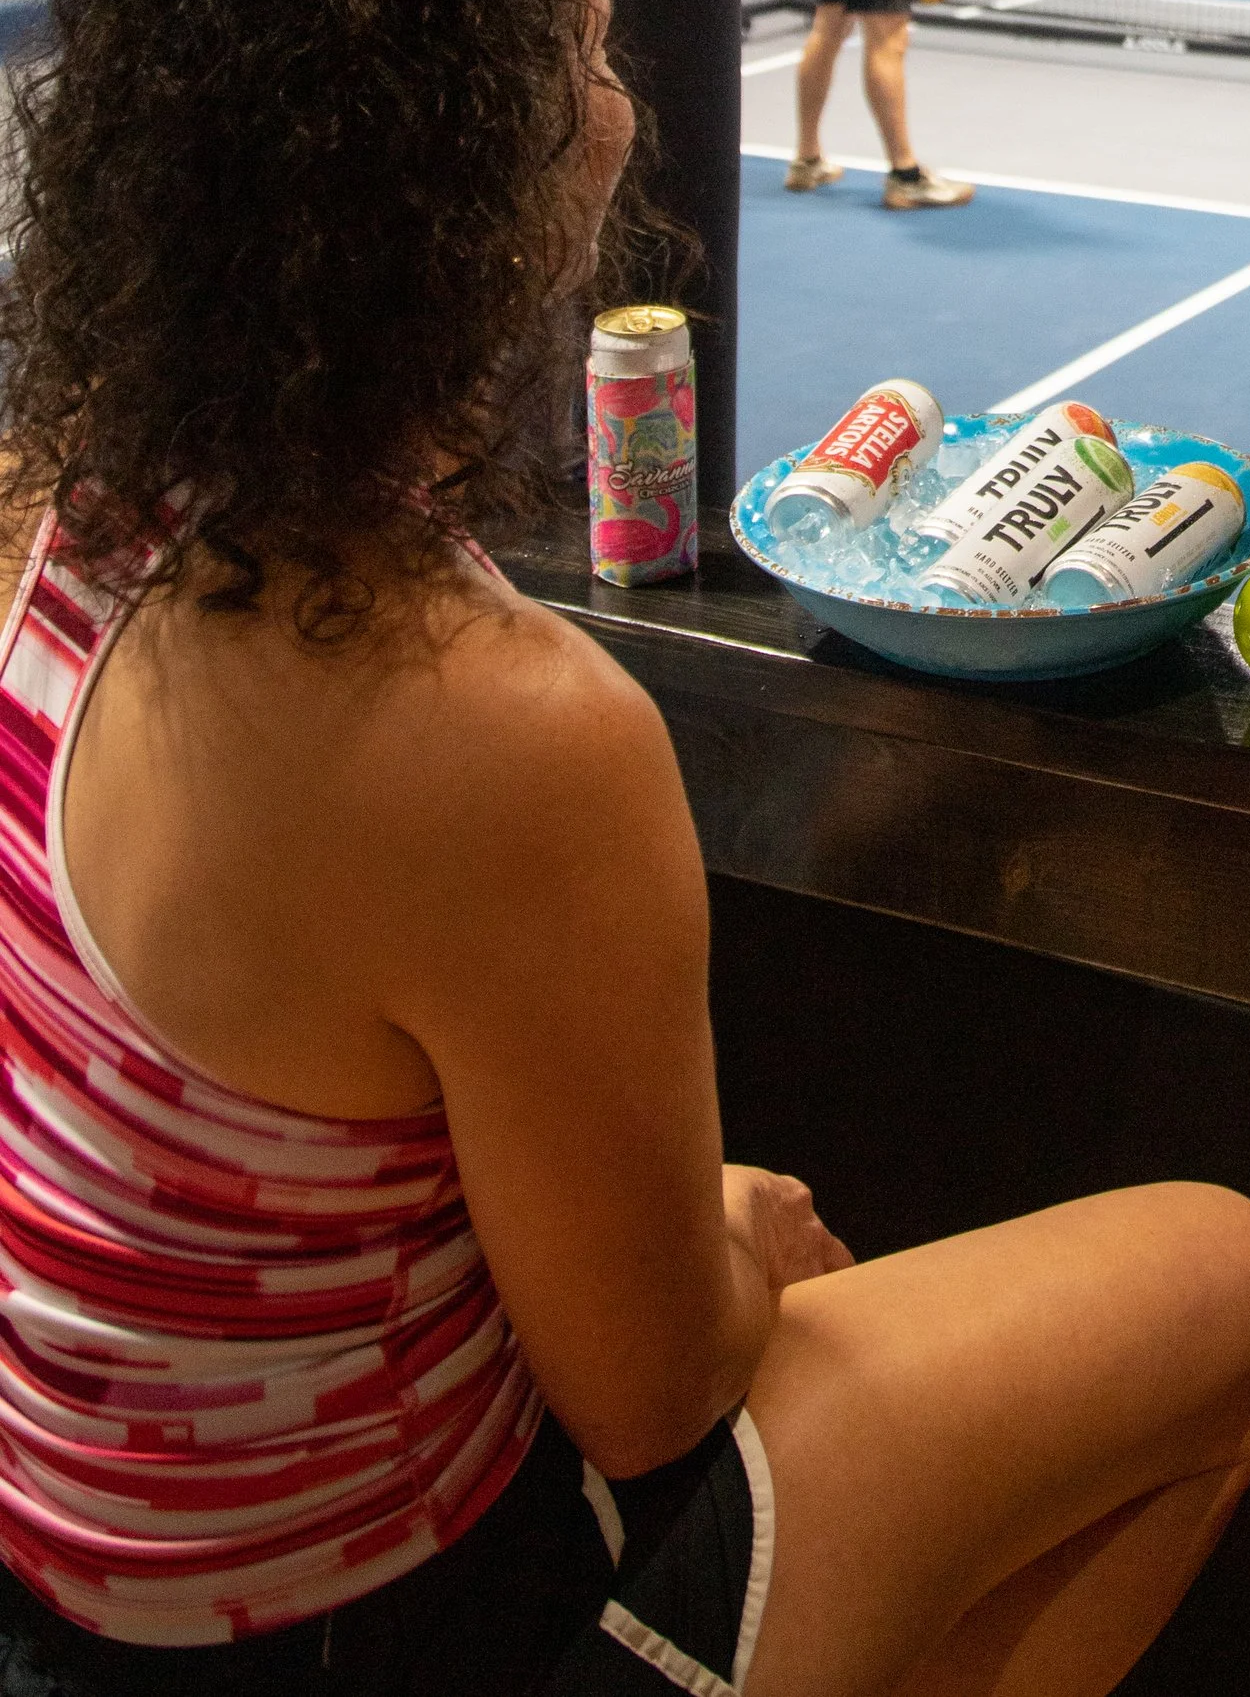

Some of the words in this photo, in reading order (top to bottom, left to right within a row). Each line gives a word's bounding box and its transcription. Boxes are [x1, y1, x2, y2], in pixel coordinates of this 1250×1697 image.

[825, 403, 886, 458] ARTOIS
[850, 411, 909, 469] STELLA
[608, 457, 697, 490] Savann
[968, 506, 984, 520] HAR
[982, 465, 1083, 552] TRULY
[1094, 482, 1182, 533] TRULY
[974, 552, 996, 569] HARD
[995, 566, 1019, 598] SELTZER
[1107, 540, 1136, 563] SELTZER
